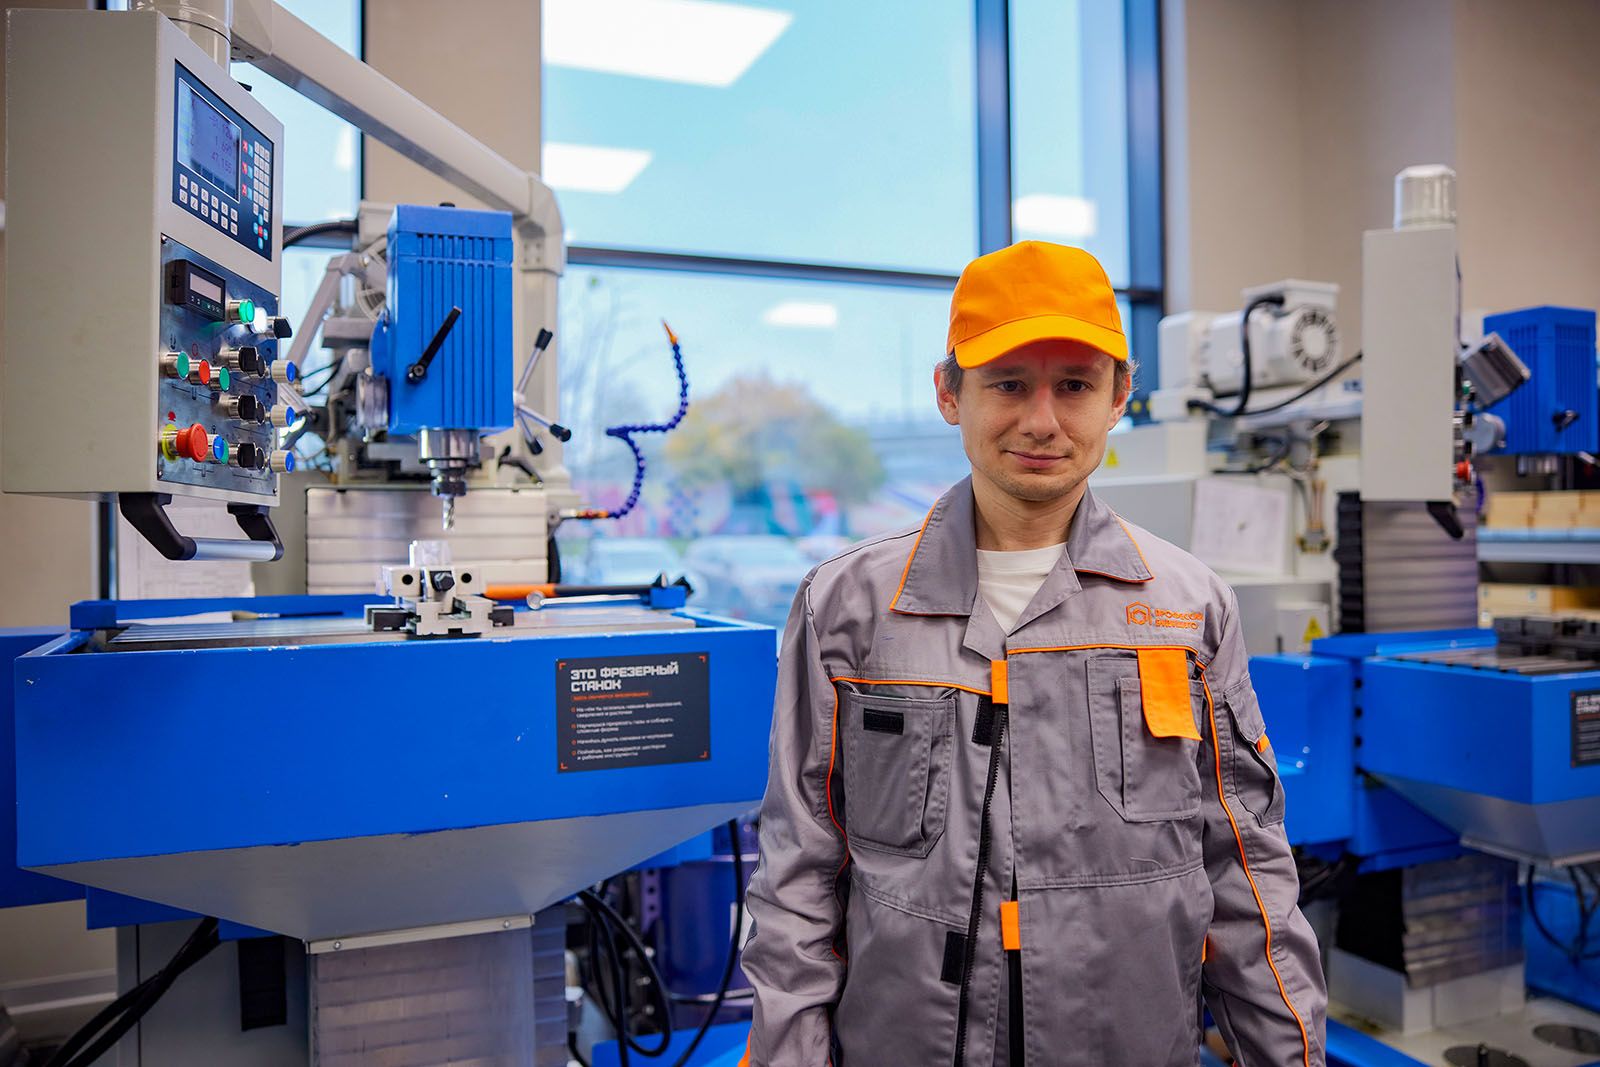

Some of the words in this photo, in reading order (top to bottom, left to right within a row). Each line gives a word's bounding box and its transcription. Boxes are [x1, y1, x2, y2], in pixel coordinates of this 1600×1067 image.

[570, 668, 596, 680] ЭТО
[600, 661, 679, 678] ФРЕЗЕРНЫЙ
[570, 679, 622, 692] СТАНОК
